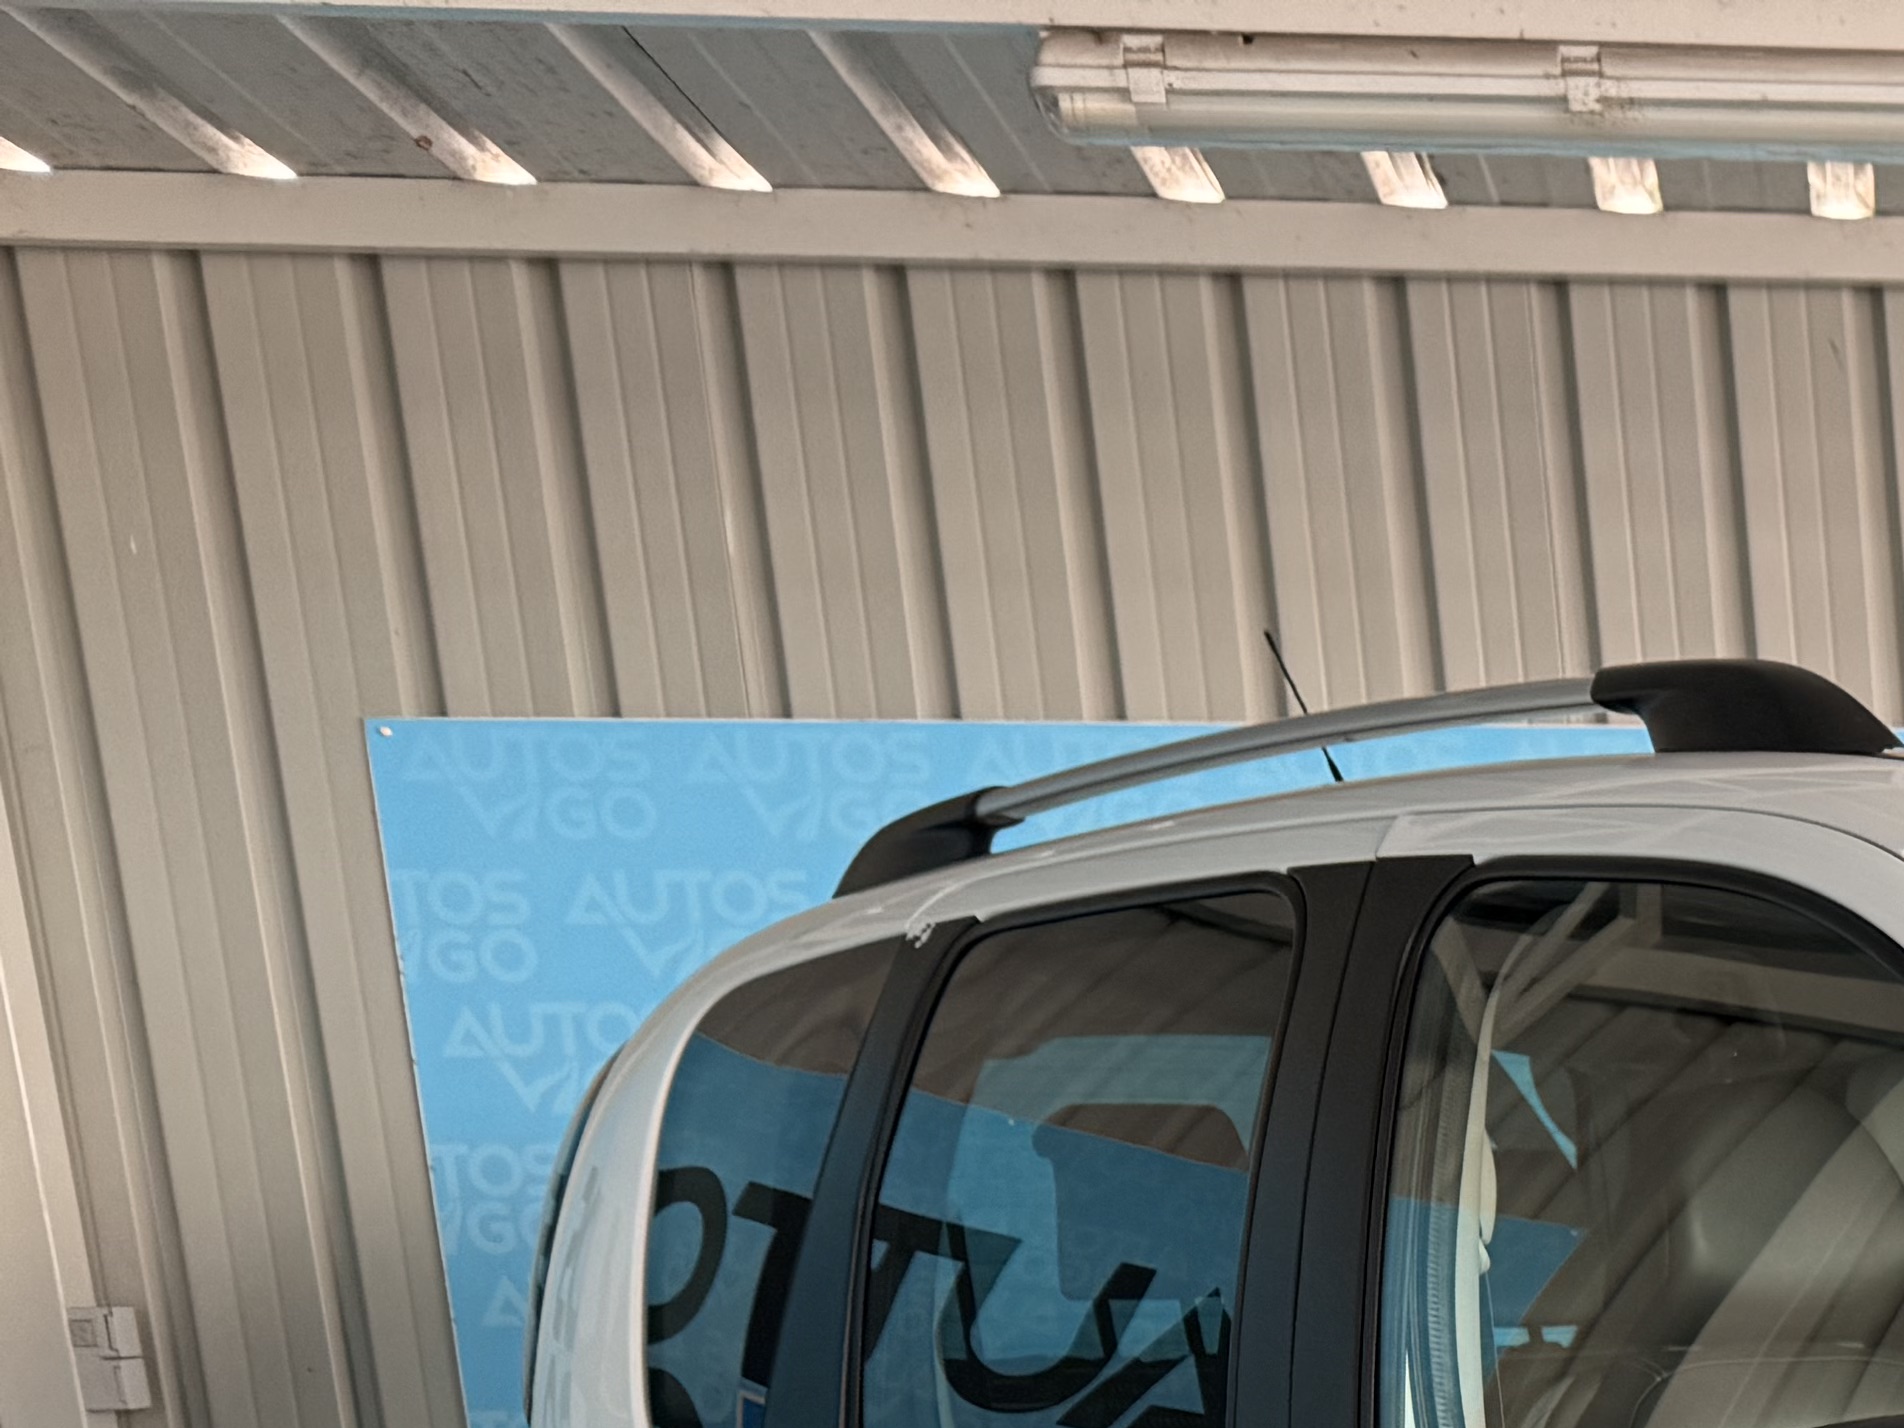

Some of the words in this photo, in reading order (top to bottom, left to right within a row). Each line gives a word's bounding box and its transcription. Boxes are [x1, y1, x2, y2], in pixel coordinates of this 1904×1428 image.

[399, 732, 654, 785] AUTOS
[684, 732, 932, 786] AUTOS
[452, 786, 659, 841] VIGO
[390, 868, 531, 926] TOS
[441, 1000, 637, 1058] AUTO
[428, 1142, 559, 1197] TOS
